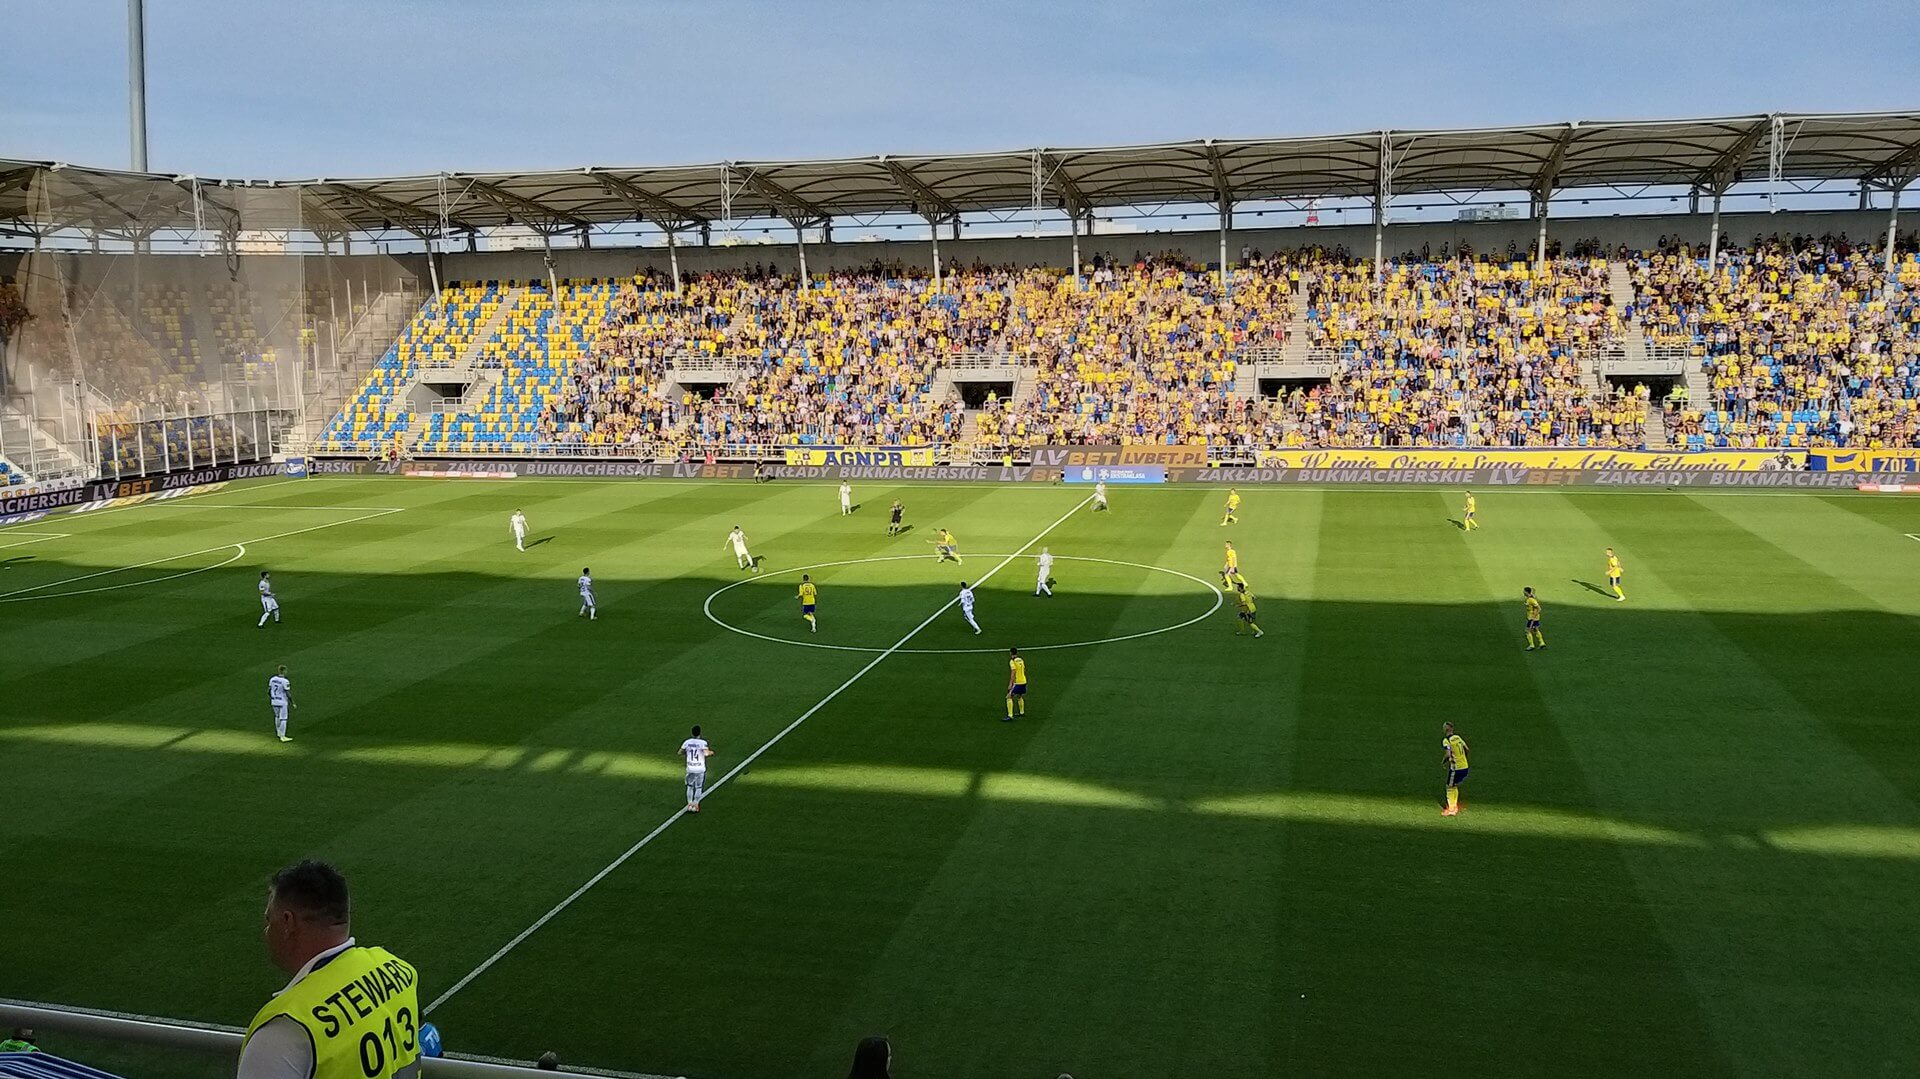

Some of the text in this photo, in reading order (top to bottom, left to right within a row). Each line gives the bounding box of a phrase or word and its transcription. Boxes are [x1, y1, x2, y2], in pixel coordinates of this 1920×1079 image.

[1316, 366, 1327, 374] 16
[822, 451, 904, 467] AGNPR
[1033, 450, 1118, 466] LV BET
[1125, 452, 1204, 465] LVBET.PL
[1300, 452, 1329, 469] W
[161, 469, 223, 489] ZAKŁADY
[525, 463, 663, 476] BUKMACHERSKIE
[673, 463, 704, 478] LV
[702, 466, 743, 478] BET
[763, 466, 831, 478] AKŁADY
[839, 466, 989, 479] BUKMACHERSKIE
[999, 467, 1033, 482] LV
[1196, 469, 1288, 482] ZAKŁADY
[1297, 469, 1476, 483] BUKMACHERSKIE
[1488, 469, 1529, 485] LV
[1526, 471, 1582, 485] BET
[1594, 471, 1699, 485] ZAKŁADY
[1709, 471, 1907, 486] BUKMACHERSKIE
[92, 482, 119, 501] LV
[118, 479, 154, 498] BET
[689, 749, 700, 762] 14
[312, 960, 413, 1038] STEWARD
[359, 1007, 414, 1078] 013
